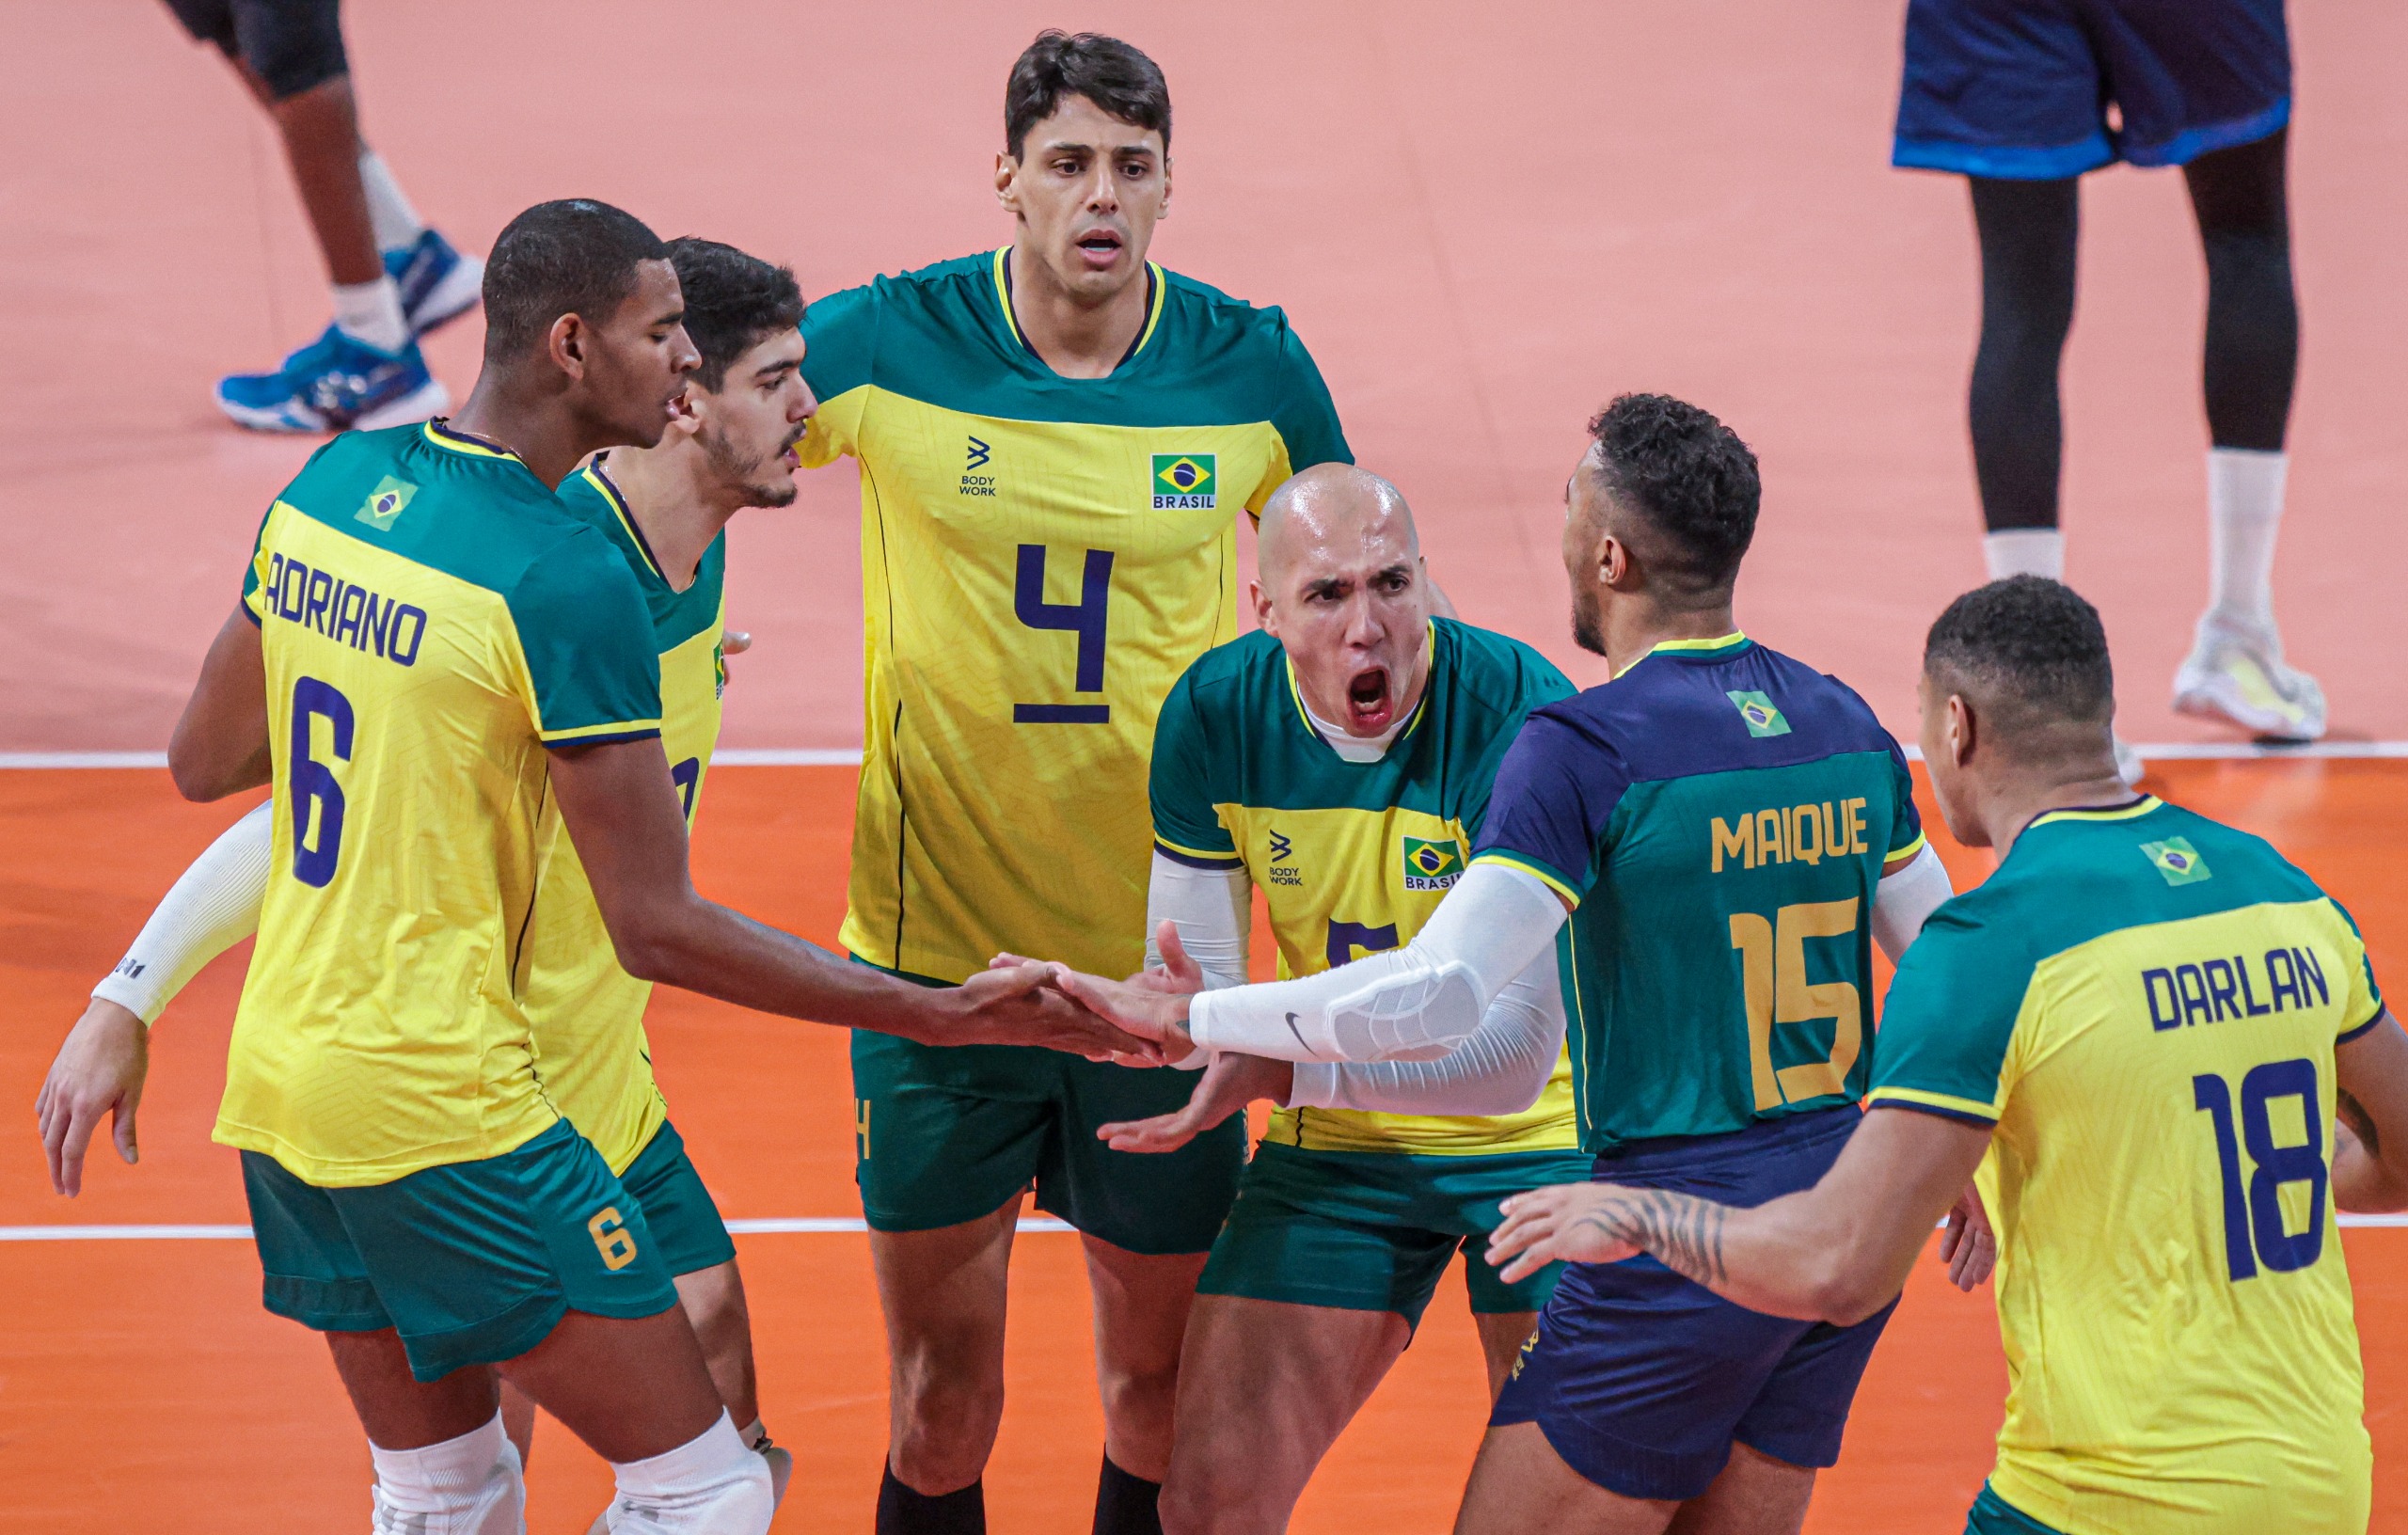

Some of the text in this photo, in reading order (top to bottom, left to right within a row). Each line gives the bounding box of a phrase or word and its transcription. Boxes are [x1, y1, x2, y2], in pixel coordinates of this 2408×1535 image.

[959, 485, 996, 497] WORK
[961, 475, 995, 485] BODY
[1153, 496, 1214, 508] BRASIL
[264, 551, 428, 668] ADRIANO
[1014, 544, 1115, 692] 4
[290, 675, 355, 889] 6
[1269, 866, 1299, 877] BODY
[1711, 797, 1868, 873] MAIQUE
[1269, 875, 1303, 886] WORK
[1729, 896, 1861, 1111] 15
[2141, 945, 2331, 1033] DARLAN
[2192, 1057, 2328, 1282] 18
[588, 1207, 638, 1271] 6
